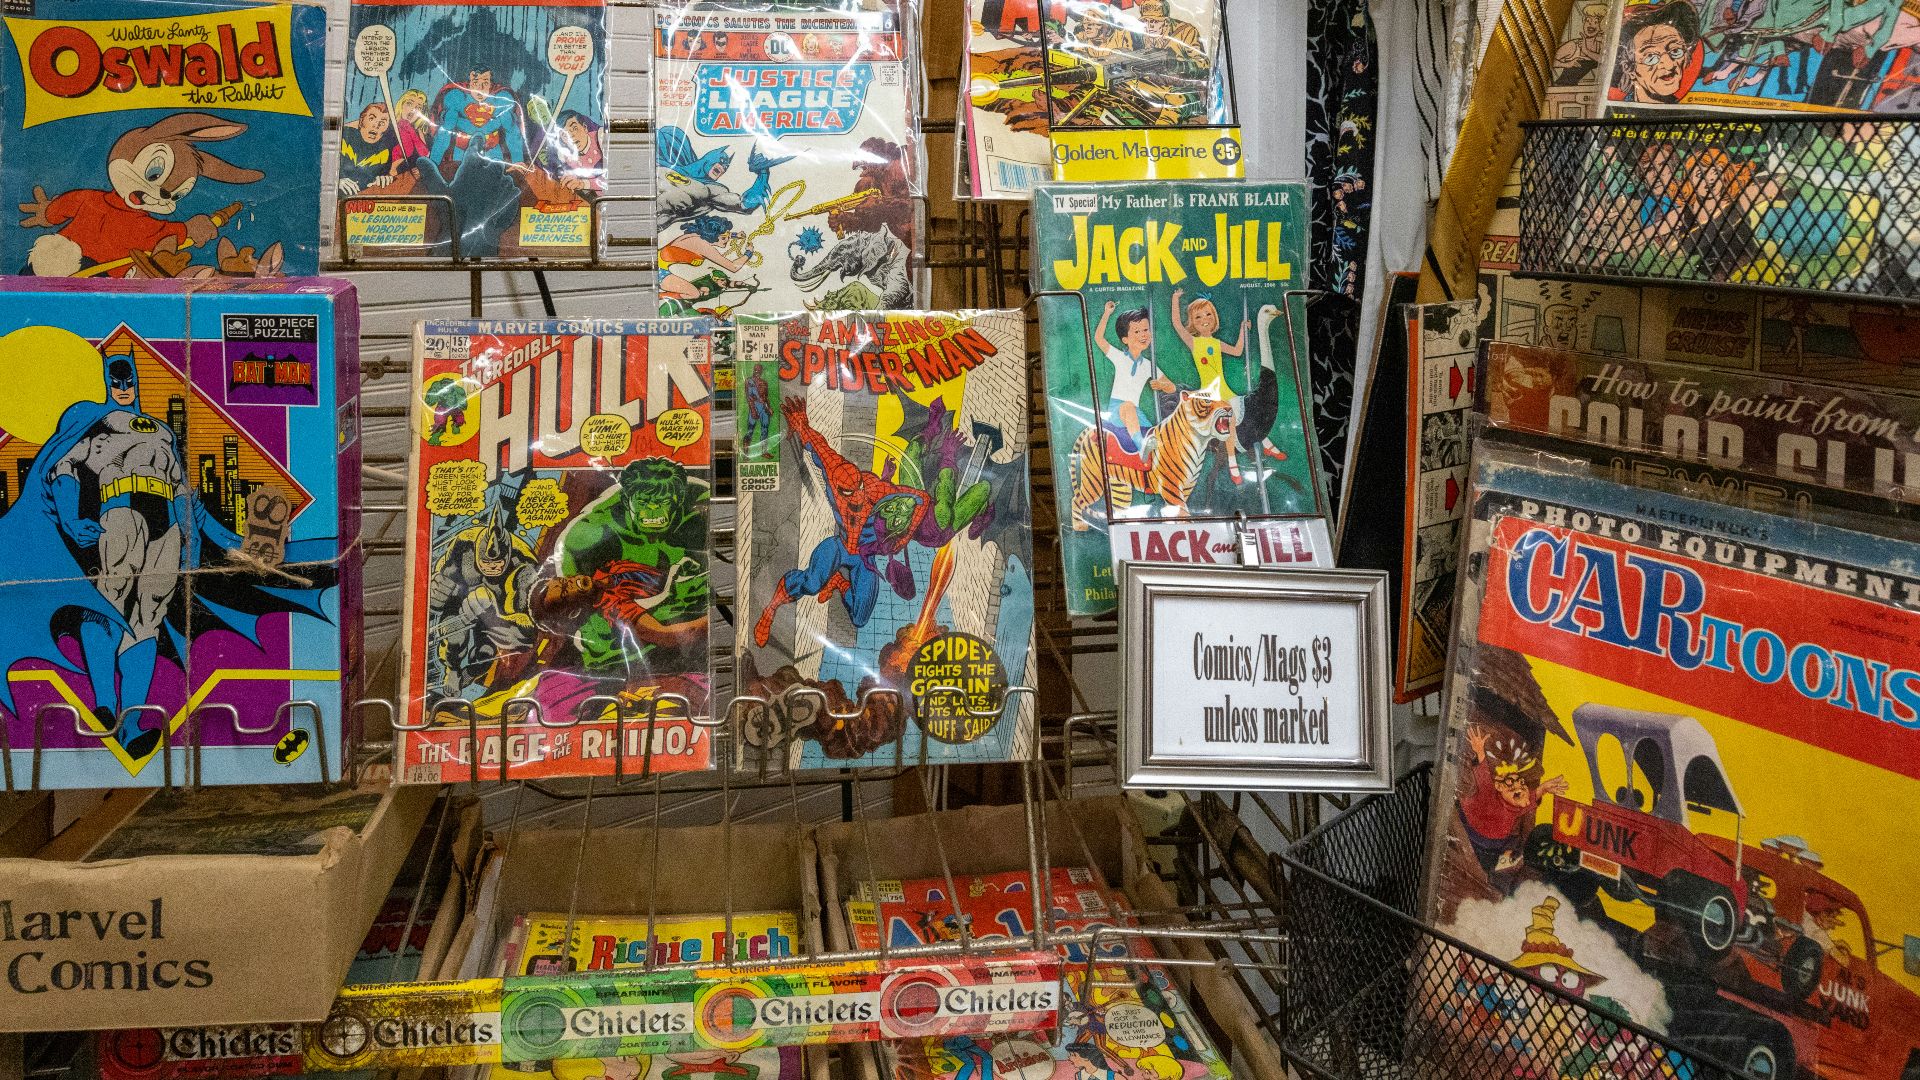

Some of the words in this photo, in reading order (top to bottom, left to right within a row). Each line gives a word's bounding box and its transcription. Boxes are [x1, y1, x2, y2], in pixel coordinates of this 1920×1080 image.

[106, 25, 165, 42] Walter
[167, 22, 212, 42] Lantz
[657, 13, 672, 26] DC
[724, 17, 771, 30] SALUTES
[775, 17, 796, 30] THE
[28, 20, 284, 98] Oswald
[709, 67, 857, 88] JUSTICE
[182, 88, 217, 104] the
[219, 83, 286, 103] Rabbit
[708, 89, 852, 109] LEAGUE
[700, 113, 713, 125] of
[712, 111, 845, 130] AMERICA
[1053, 143, 1119, 165] Golden
[1122, 141, 1207, 165] Magazine
[346, 200, 376, 214] WHO
[1054, 197, 1065, 208] TV
[1068, 196, 1097, 209] Special!
[1101, 195, 1122, 210] My
[1126, 195, 1168, 208] Father
[1173, 194, 1184, 208] Is
[1189, 193, 1240, 207] FRANK
[1244, 192, 1290, 207] BLAIR
[366, 225, 408, 233] NOBODY
[522, 234, 583, 243] WEAKNESS
[534, 224, 580, 233] SECRET
[1053, 215, 1188, 291] JACK
[1181, 237, 1208, 252] AND
[1194, 212, 1291, 287] JILL
[1481, 240, 1520, 264] REA
[254, 318, 276, 328] 200
[280, 318, 315, 328] PIECE
[254, 328, 301, 339] PUZZLE
[478, 322, 548, 334] MARVEL
[557, 321, 624, 334] COMICS
[636, 321, 694, 334] GROUP
[818, 315, 943, 345] AMAZING
[452, 336, 468, 347] 157
[741, 340, 758, 353] 15¢
[763, 343, 774, 353] 97
[479, 335, 710, 483] HULK
[1586, 363, 1658, 401] How
[1667, 377, 1702, 408] to
[1706, 389, 1818, 424] paint
[1811, 396, 1901, 442] from
[663, 431, 695, 441] PAY!!
[739, 464, 779, 477] MARVEL
[741, 477, 776, 485] COMICS
[1522, 500, 1643, 543] PHOTO
[1635, 503, 1770, 542] MAETERLINCK'S
[1249, 527, 1313, 564] ILL
[919, 636, 993, 662] SPIDEY
[914, 664, 962, 678] FIGHTS
[967, 663, 996, 676] THE
[1193, 631, 1307, 695] Comics/Mags
[1311, 634, 1332, 688] $3
[1203, 695, 1259, 744] unless
[1263, 696, 1330, 745] marked
[418, 742, 450, 765] THE
[459, 733, 547, 766] RAGE
[554, 731, 570, 745] OF
[582, 725, 705, 759] RHINO!
[552, 746, 574, 760] THE
[413, 772, 439, 782] 18.00
[1558, 806, 1639, 861] JUNK
[0, 898, 164, 942] arvel
[588, 934, 702, 970] Richie
[713, 928, 791, 960] Rich
[7, 950, 214, 995] Comics
[974, 969, 1037, 978] CINNAMON
[595, 989, 668, 998] SPEARMINT
[813, 979, 868, 988] FLAVORS
[945, 987, 1052, 1015] Chiclets
[1819, 979, 1871, 1014] JUNK
[571, 1008, 686, 1037] Chiclets
[760, 998, 873, 1027] Chiclets
[373, 1018, 494, 1048] Chiclets
[1108, 1019, 1159, 1030] REDUCTION
[169, 1027, 293, 1059] Chiclets
